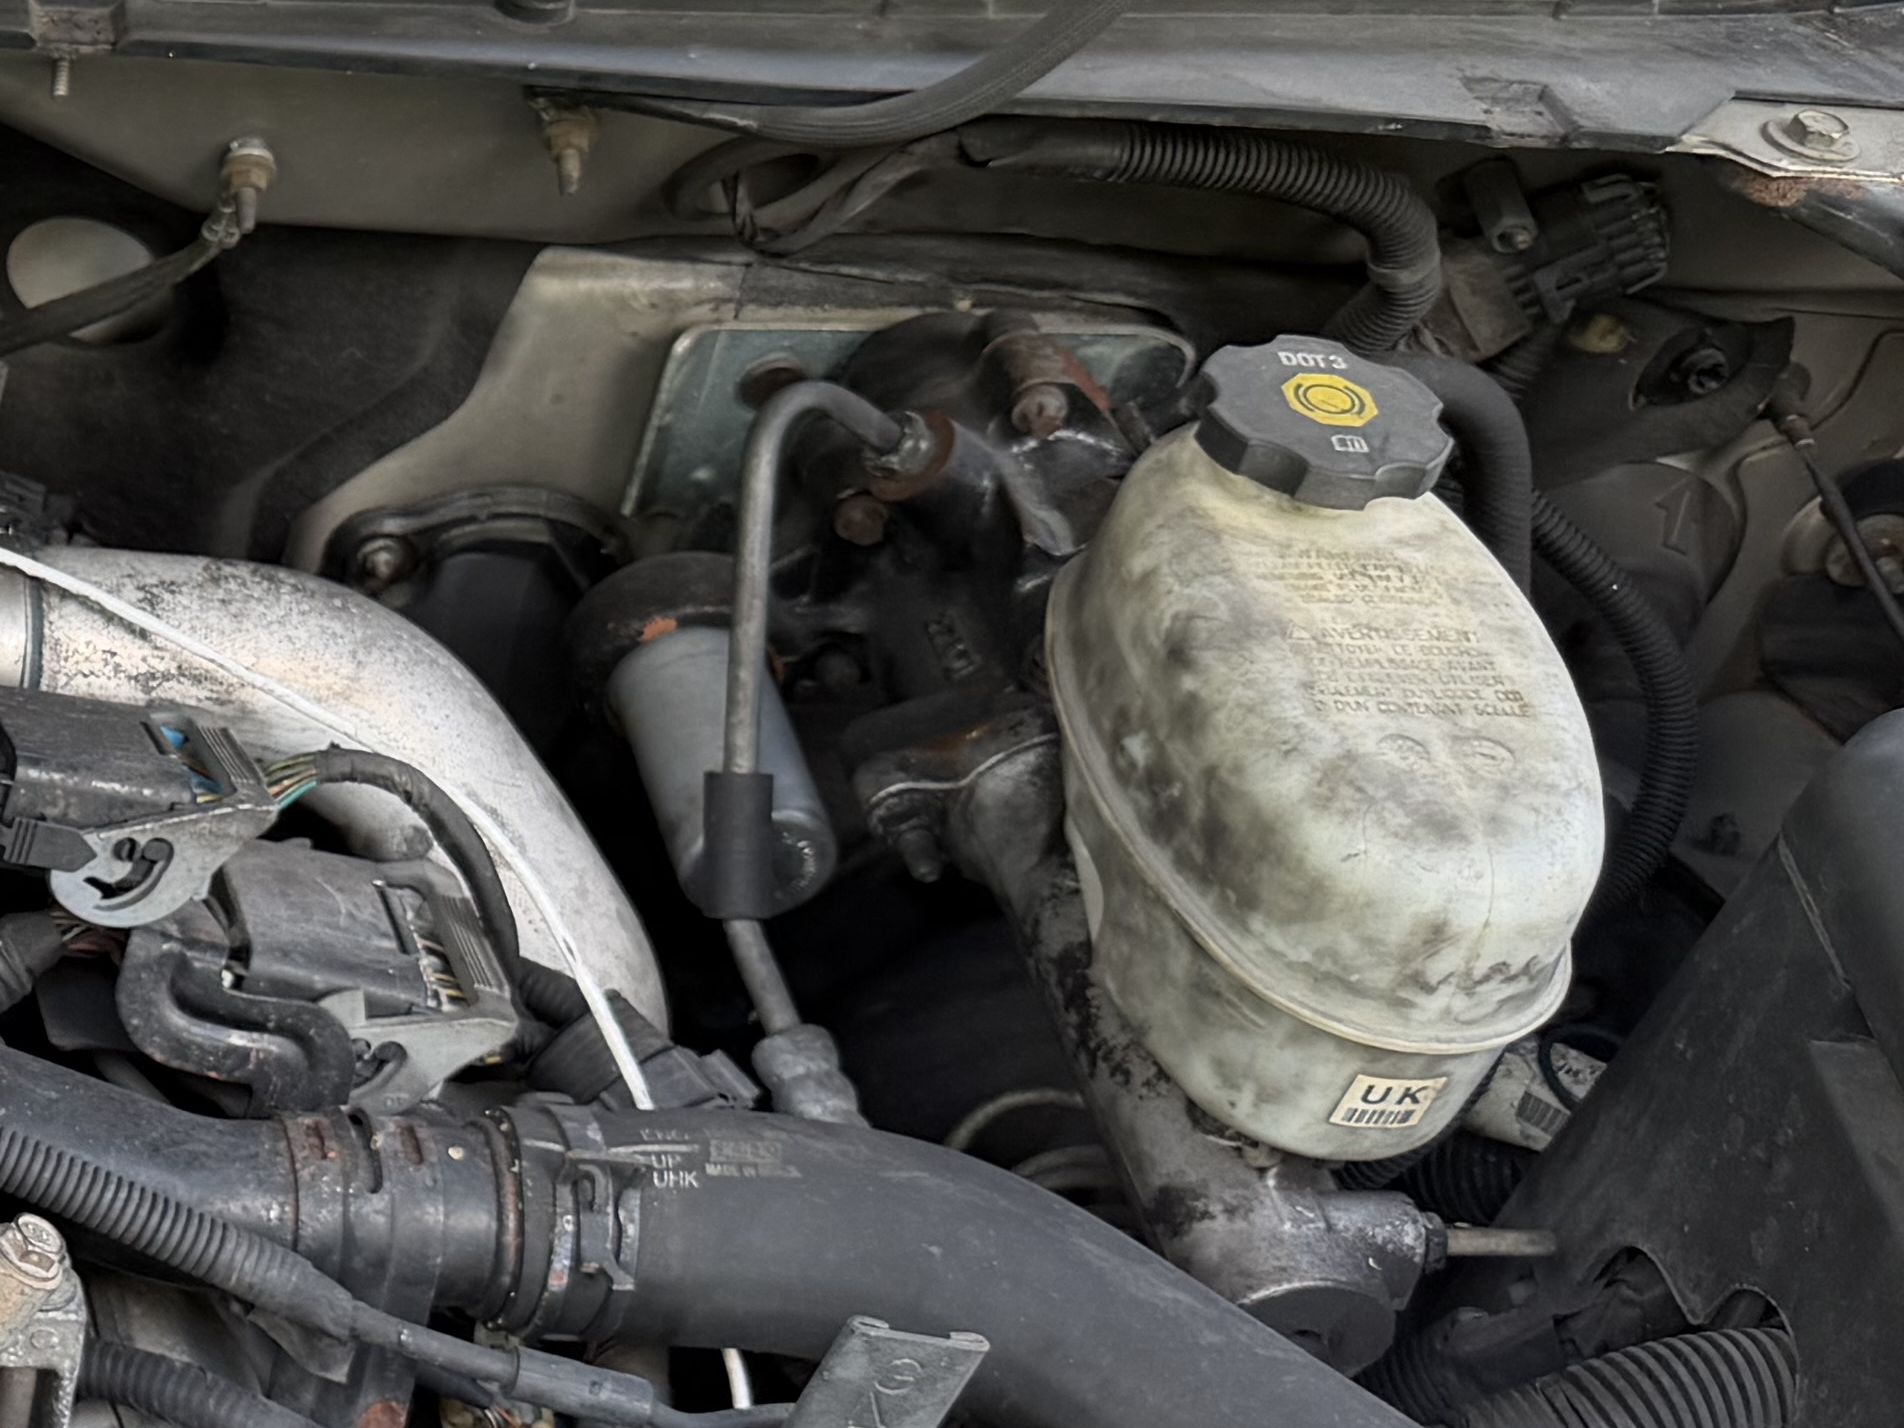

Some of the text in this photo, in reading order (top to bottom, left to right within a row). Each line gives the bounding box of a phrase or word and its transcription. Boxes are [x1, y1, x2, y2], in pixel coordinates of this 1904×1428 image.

[1277, 351, 1348, 370] DOT 3
[1378, 699, 1464, 715] CONTENANT
[1360, 1084, 1430, 1106] UK
[652, 1170, 699, 1189] UHK
